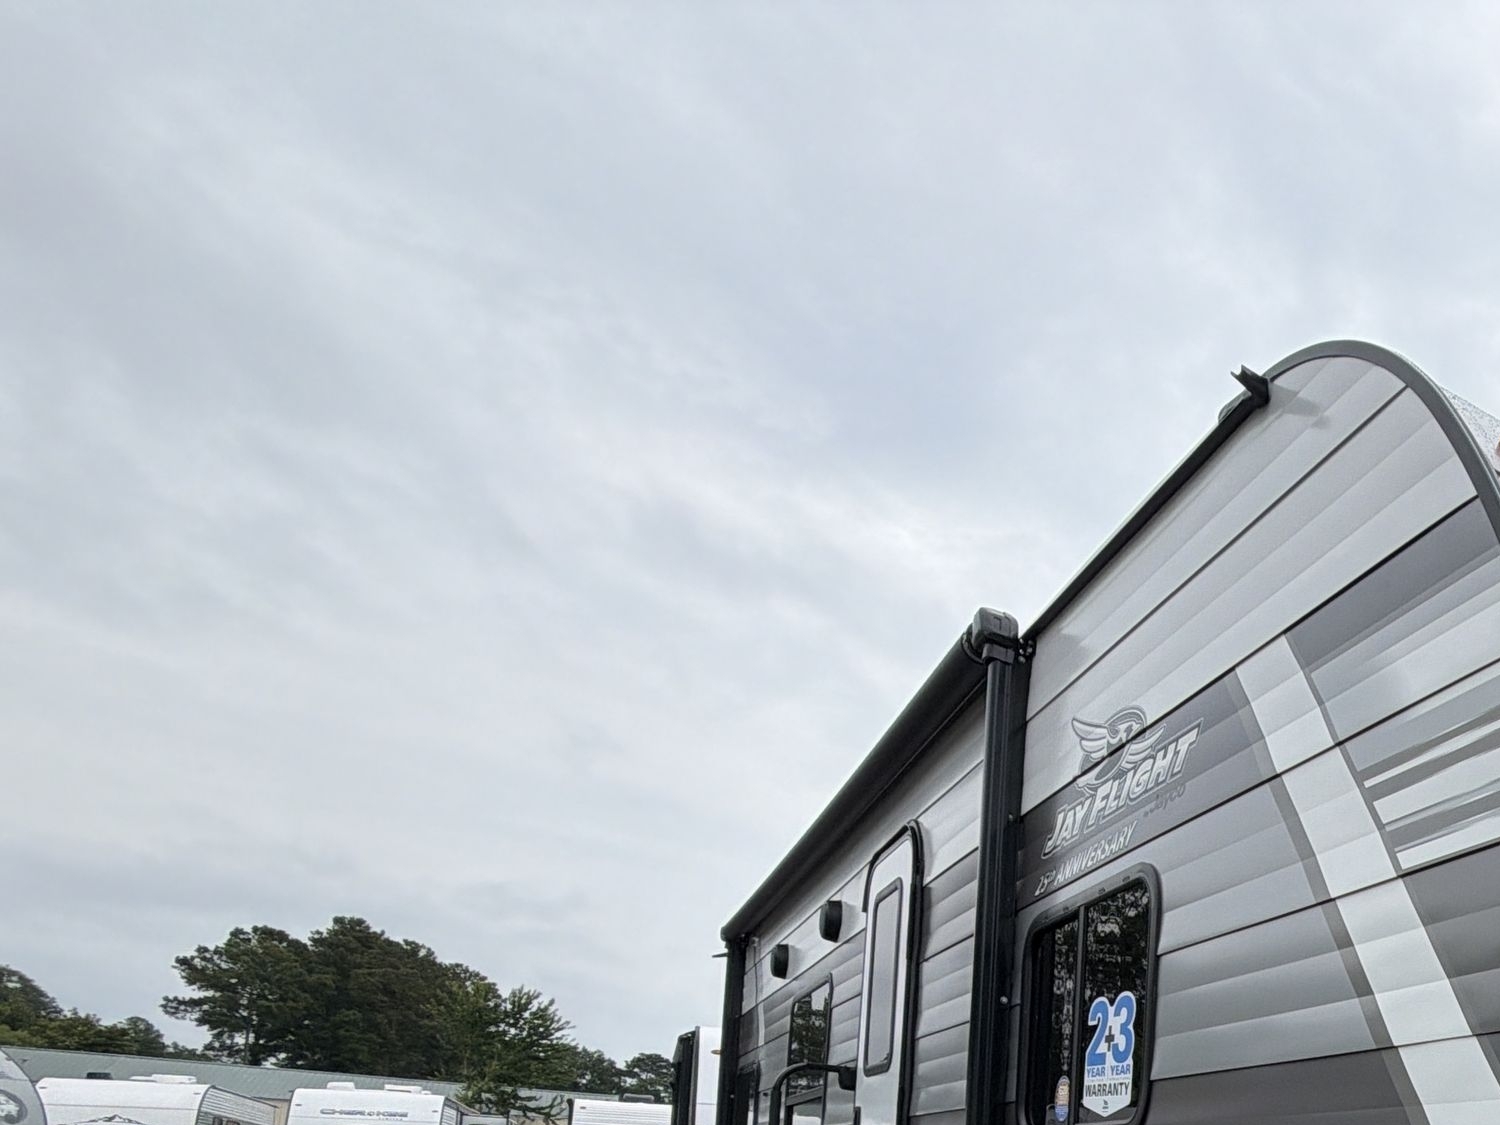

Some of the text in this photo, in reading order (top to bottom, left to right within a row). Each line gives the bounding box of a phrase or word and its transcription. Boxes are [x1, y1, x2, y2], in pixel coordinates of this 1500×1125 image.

[1043, 725, 1201, 856] JAY FLIGHT
[1054, 820, 1137, 887] ANNIVERSARY
[1085, 1082, 1130, 1098] WARRANTY
[1087, 1064, 1131, 1078] YEAR YEAR
